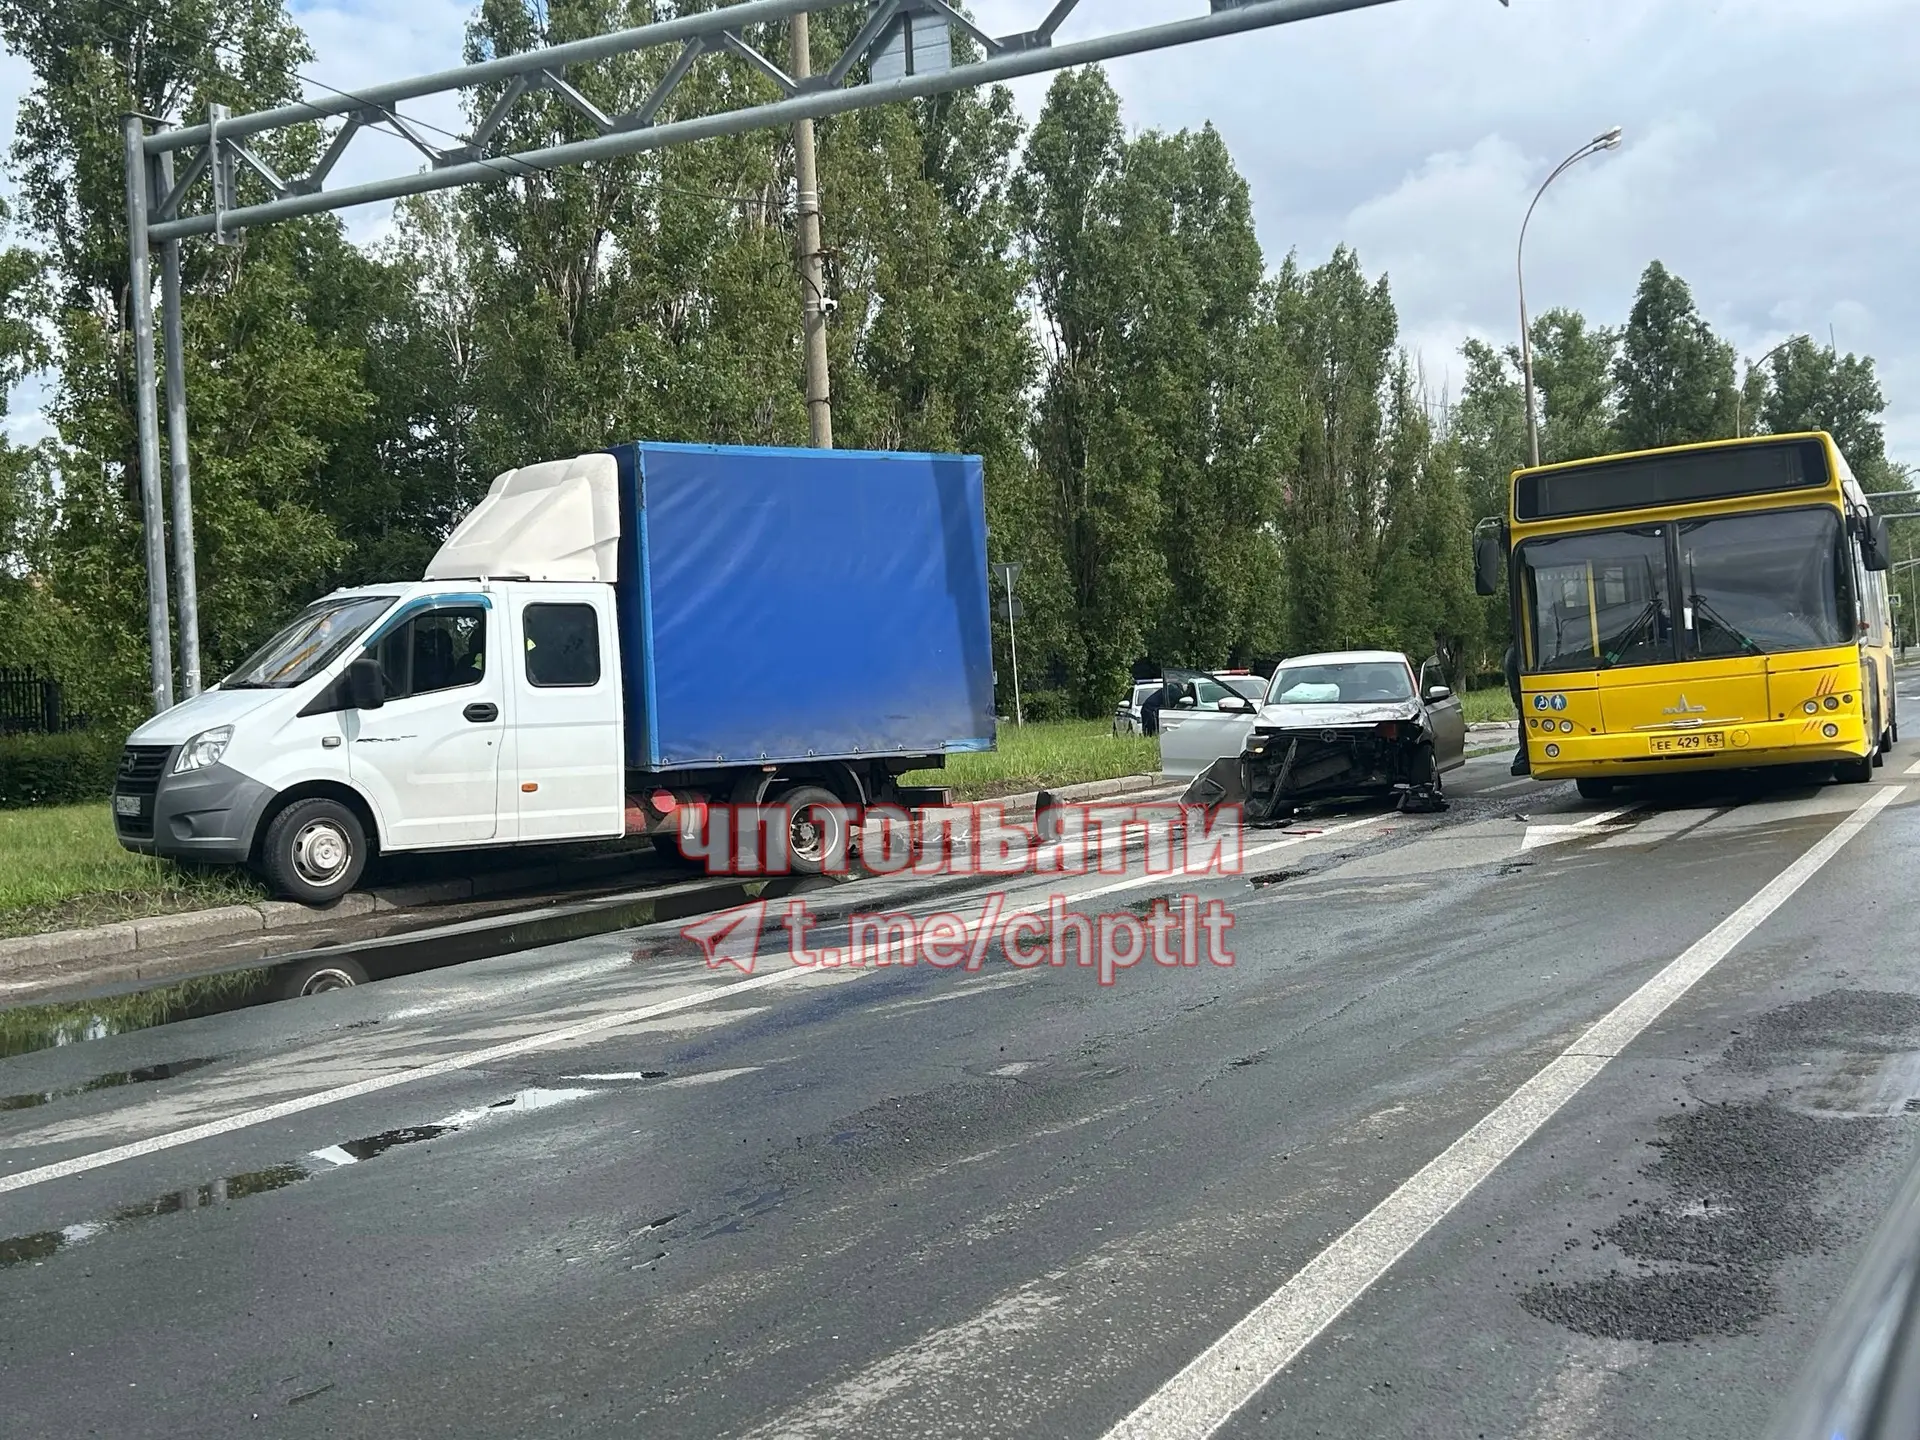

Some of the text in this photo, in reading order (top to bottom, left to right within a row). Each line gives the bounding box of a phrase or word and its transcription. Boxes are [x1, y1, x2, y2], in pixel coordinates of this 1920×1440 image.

[1656, 741, 1671, 750] ЕЕ
[1677, 736, 1700, 748] 429
[1706, 734, 1719, 743] 63
